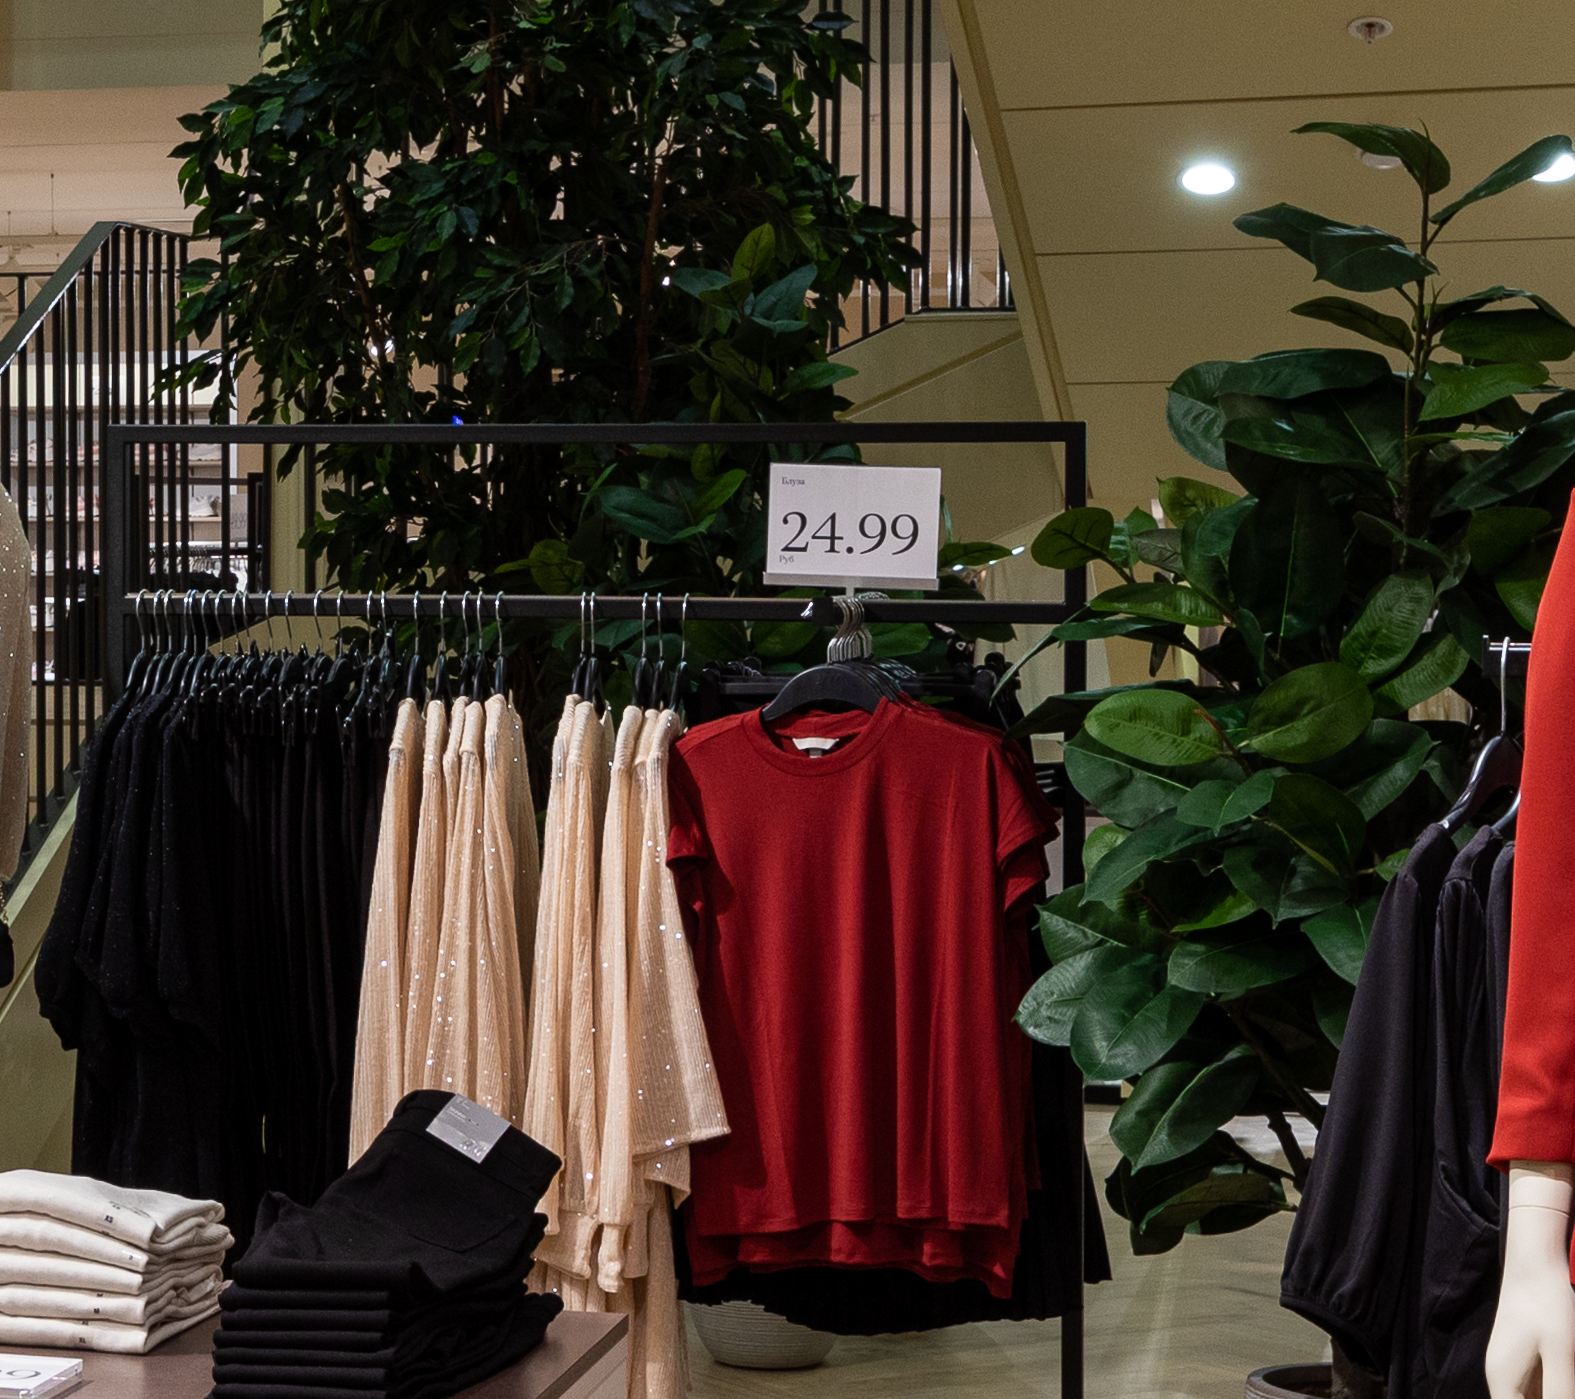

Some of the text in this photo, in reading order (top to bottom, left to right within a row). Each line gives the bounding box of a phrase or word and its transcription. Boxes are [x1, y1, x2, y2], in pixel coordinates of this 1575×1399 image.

[781, 477, 805, 486] Блуза
[780, 511, 920, 556] 24.99
[779, 555, 794, 565] Руб
